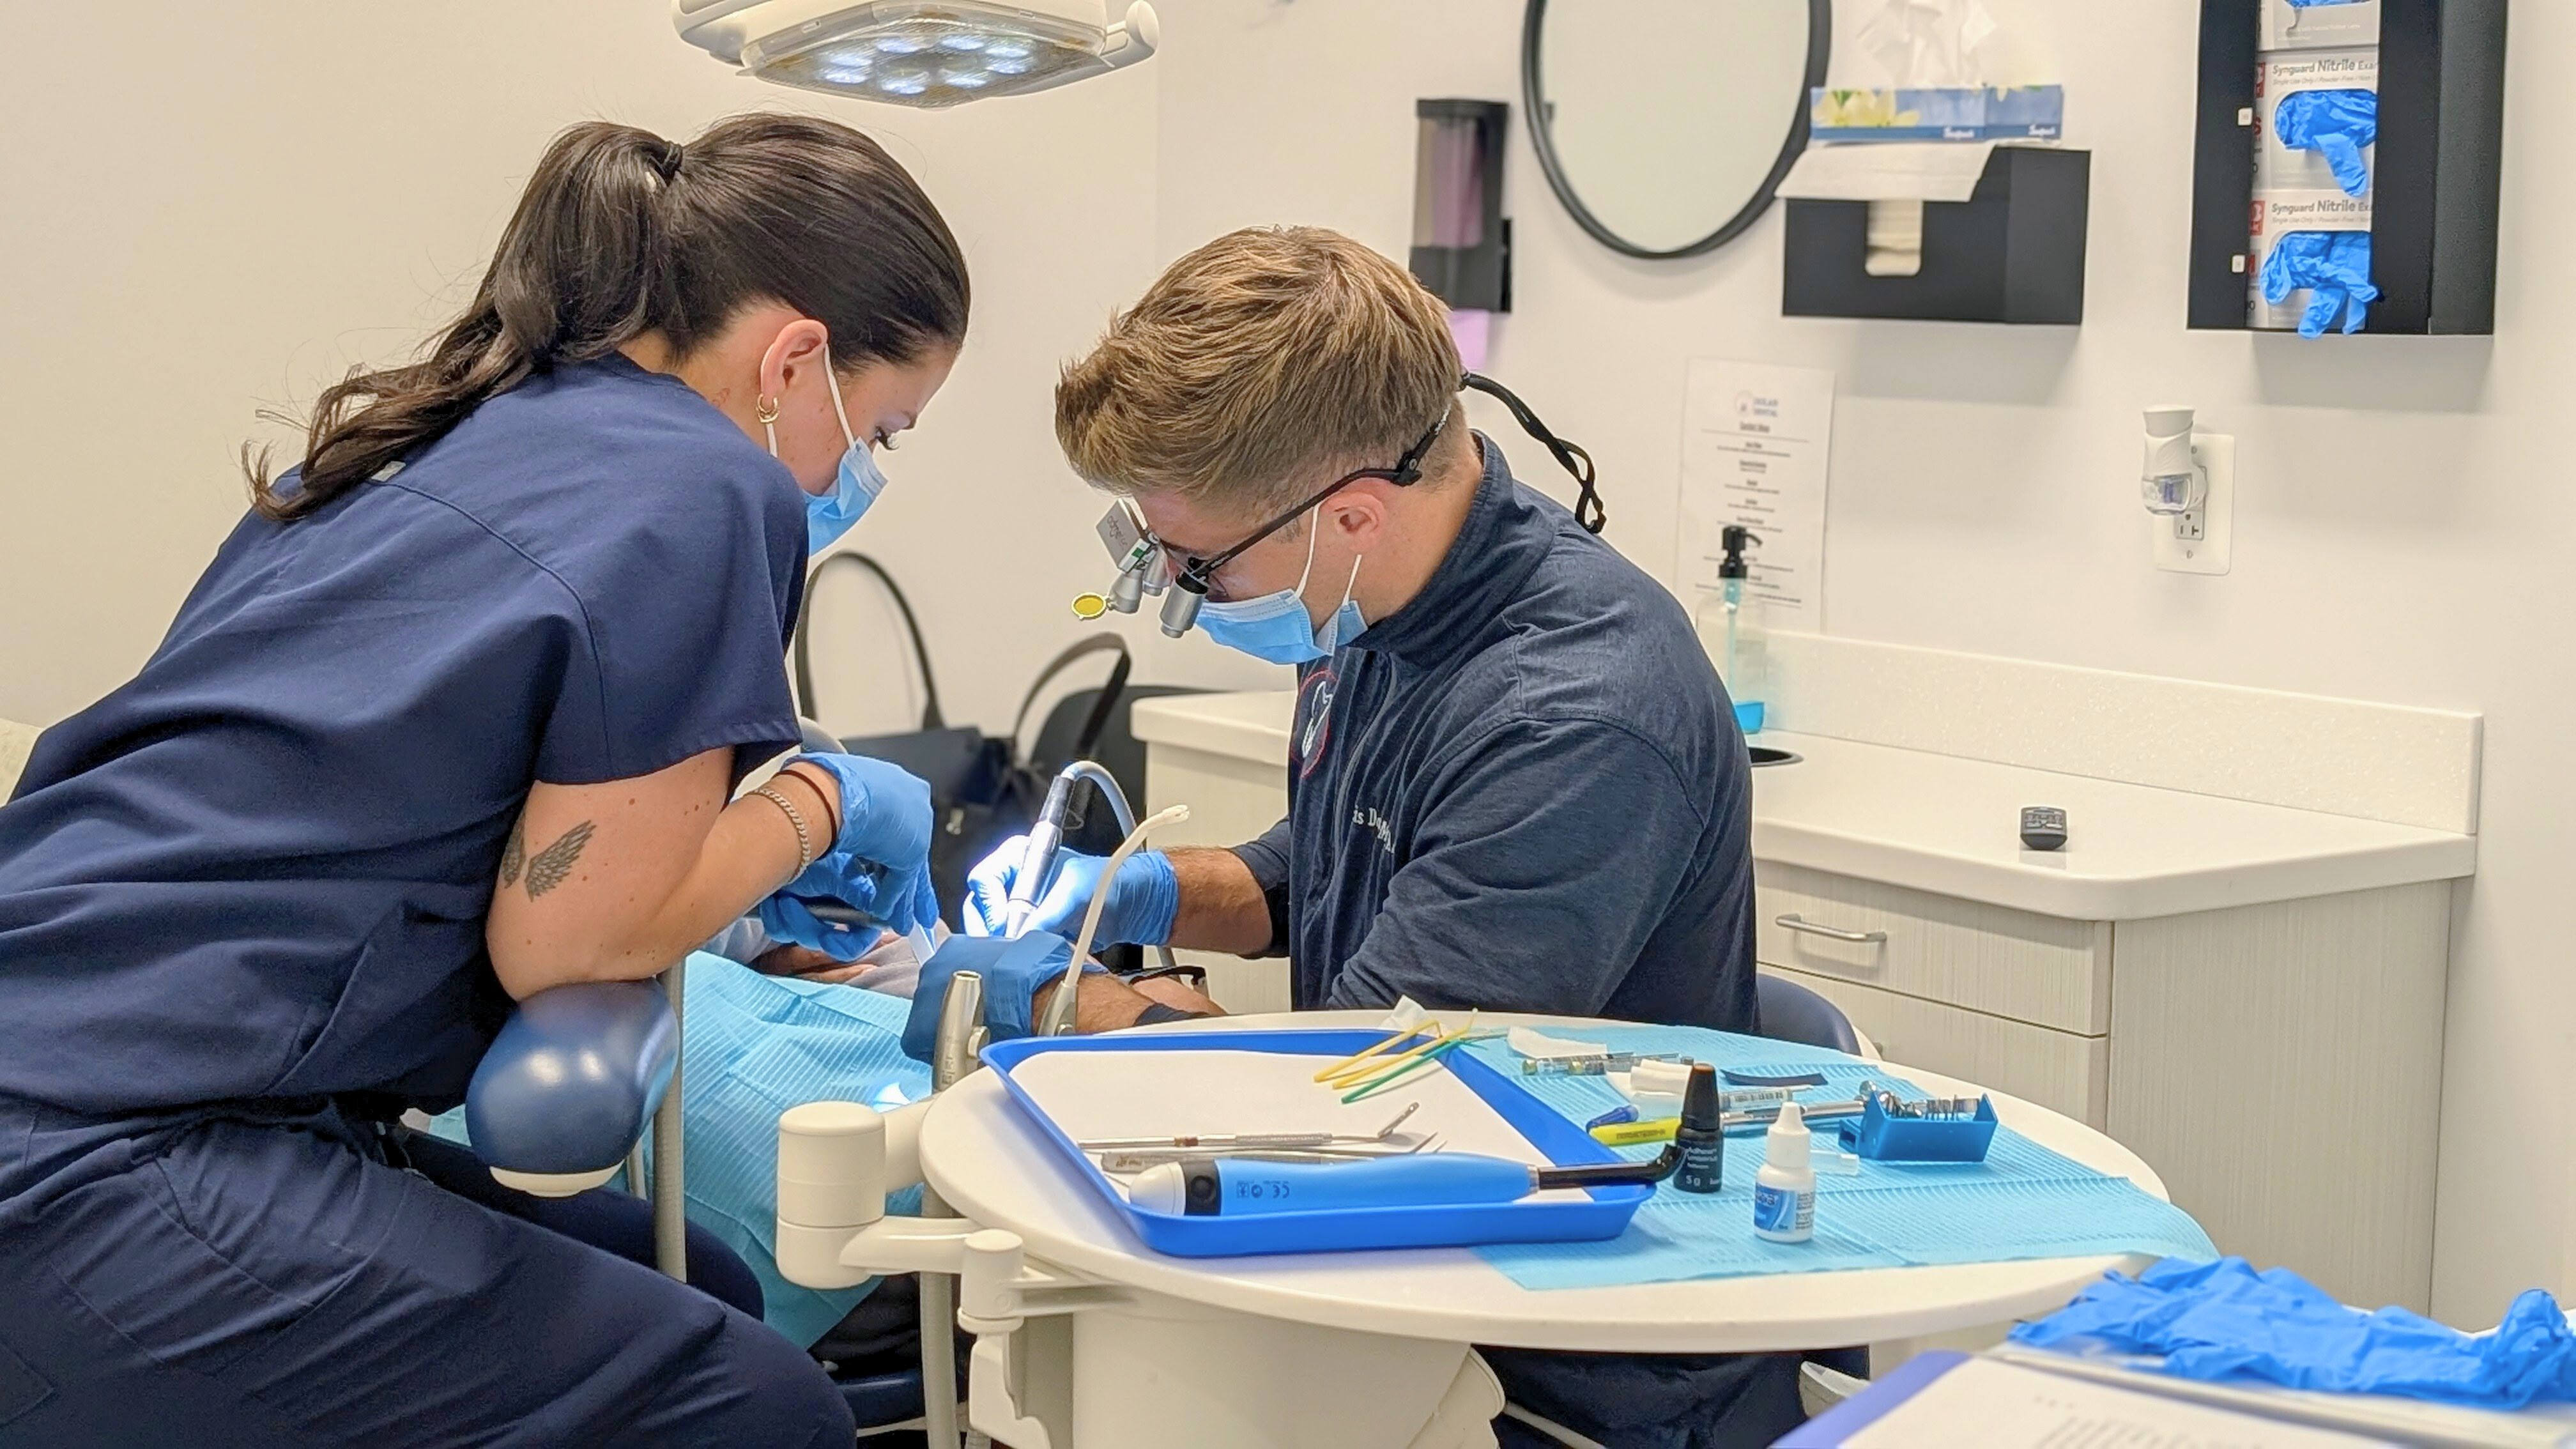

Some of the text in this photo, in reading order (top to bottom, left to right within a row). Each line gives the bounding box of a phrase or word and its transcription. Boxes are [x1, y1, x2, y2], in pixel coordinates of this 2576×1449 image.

[2273, 63, 2315, 76] Synguard
[2317, 59, 2355, 72] Nitrile
[2272, 203, 2315, 215] Synguard
[2317, 199, 2356, 212] Nitrile
[1352, 805, 1364, 825] is
